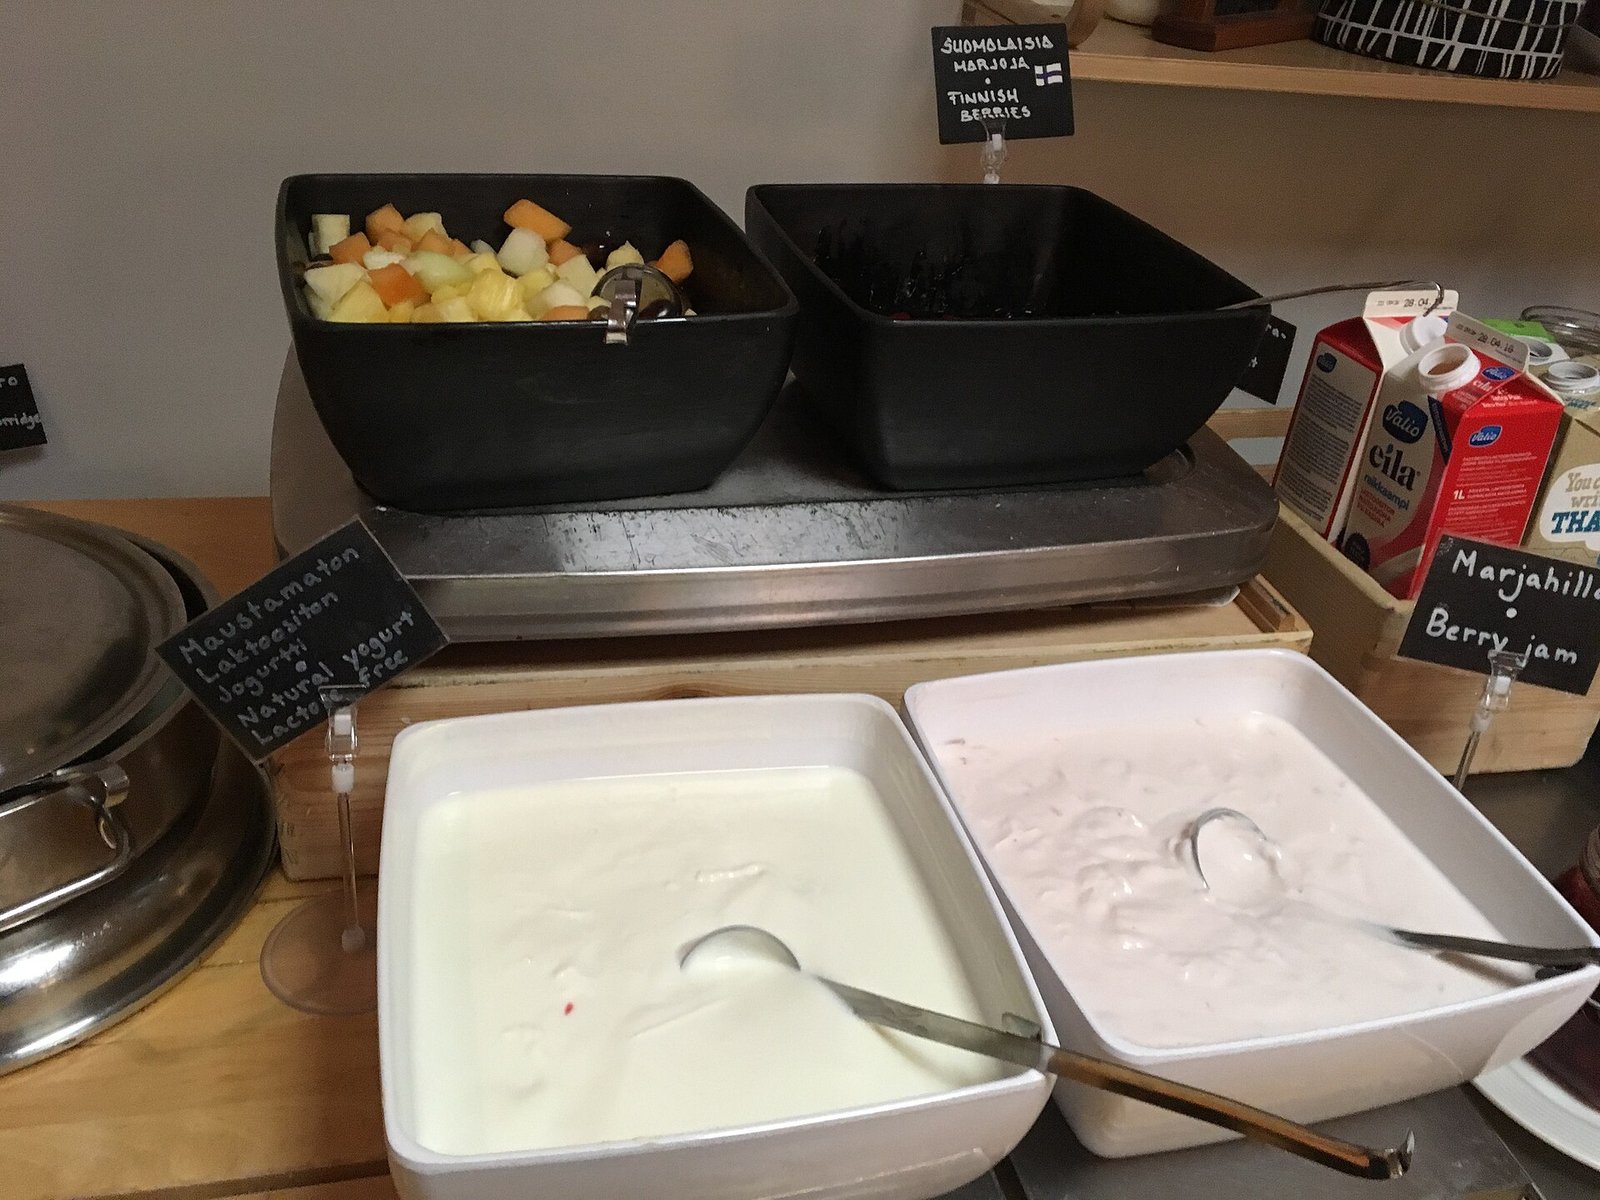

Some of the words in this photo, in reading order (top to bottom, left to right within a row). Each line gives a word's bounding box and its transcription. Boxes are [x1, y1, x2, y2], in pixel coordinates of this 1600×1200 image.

[954, 56, 1030, 73] MARJOJA
[948, 88, 1020, 105] FINNISH
[960, 105, 1031, 122] BERRIES
[1386, 408, 1420, 437] Valio
[1471, 432, 1497, 442] Valio
[1369, 443, 1416, 492] eila
[1453, 490, 1465, 500] 1L
[1565, 472, 1593, 493] You
[1571, 489, 1600, 508] wri
[179, 547, 359, 665] Maustamaton
[196, 591, 338, 684] Laktoositon
[1425, 607, 1509, 657] Berry
[1515, 634, 1577, 668] jam
[357, 650, 408, 689] free
[237, 661, 334, 728] Natural
